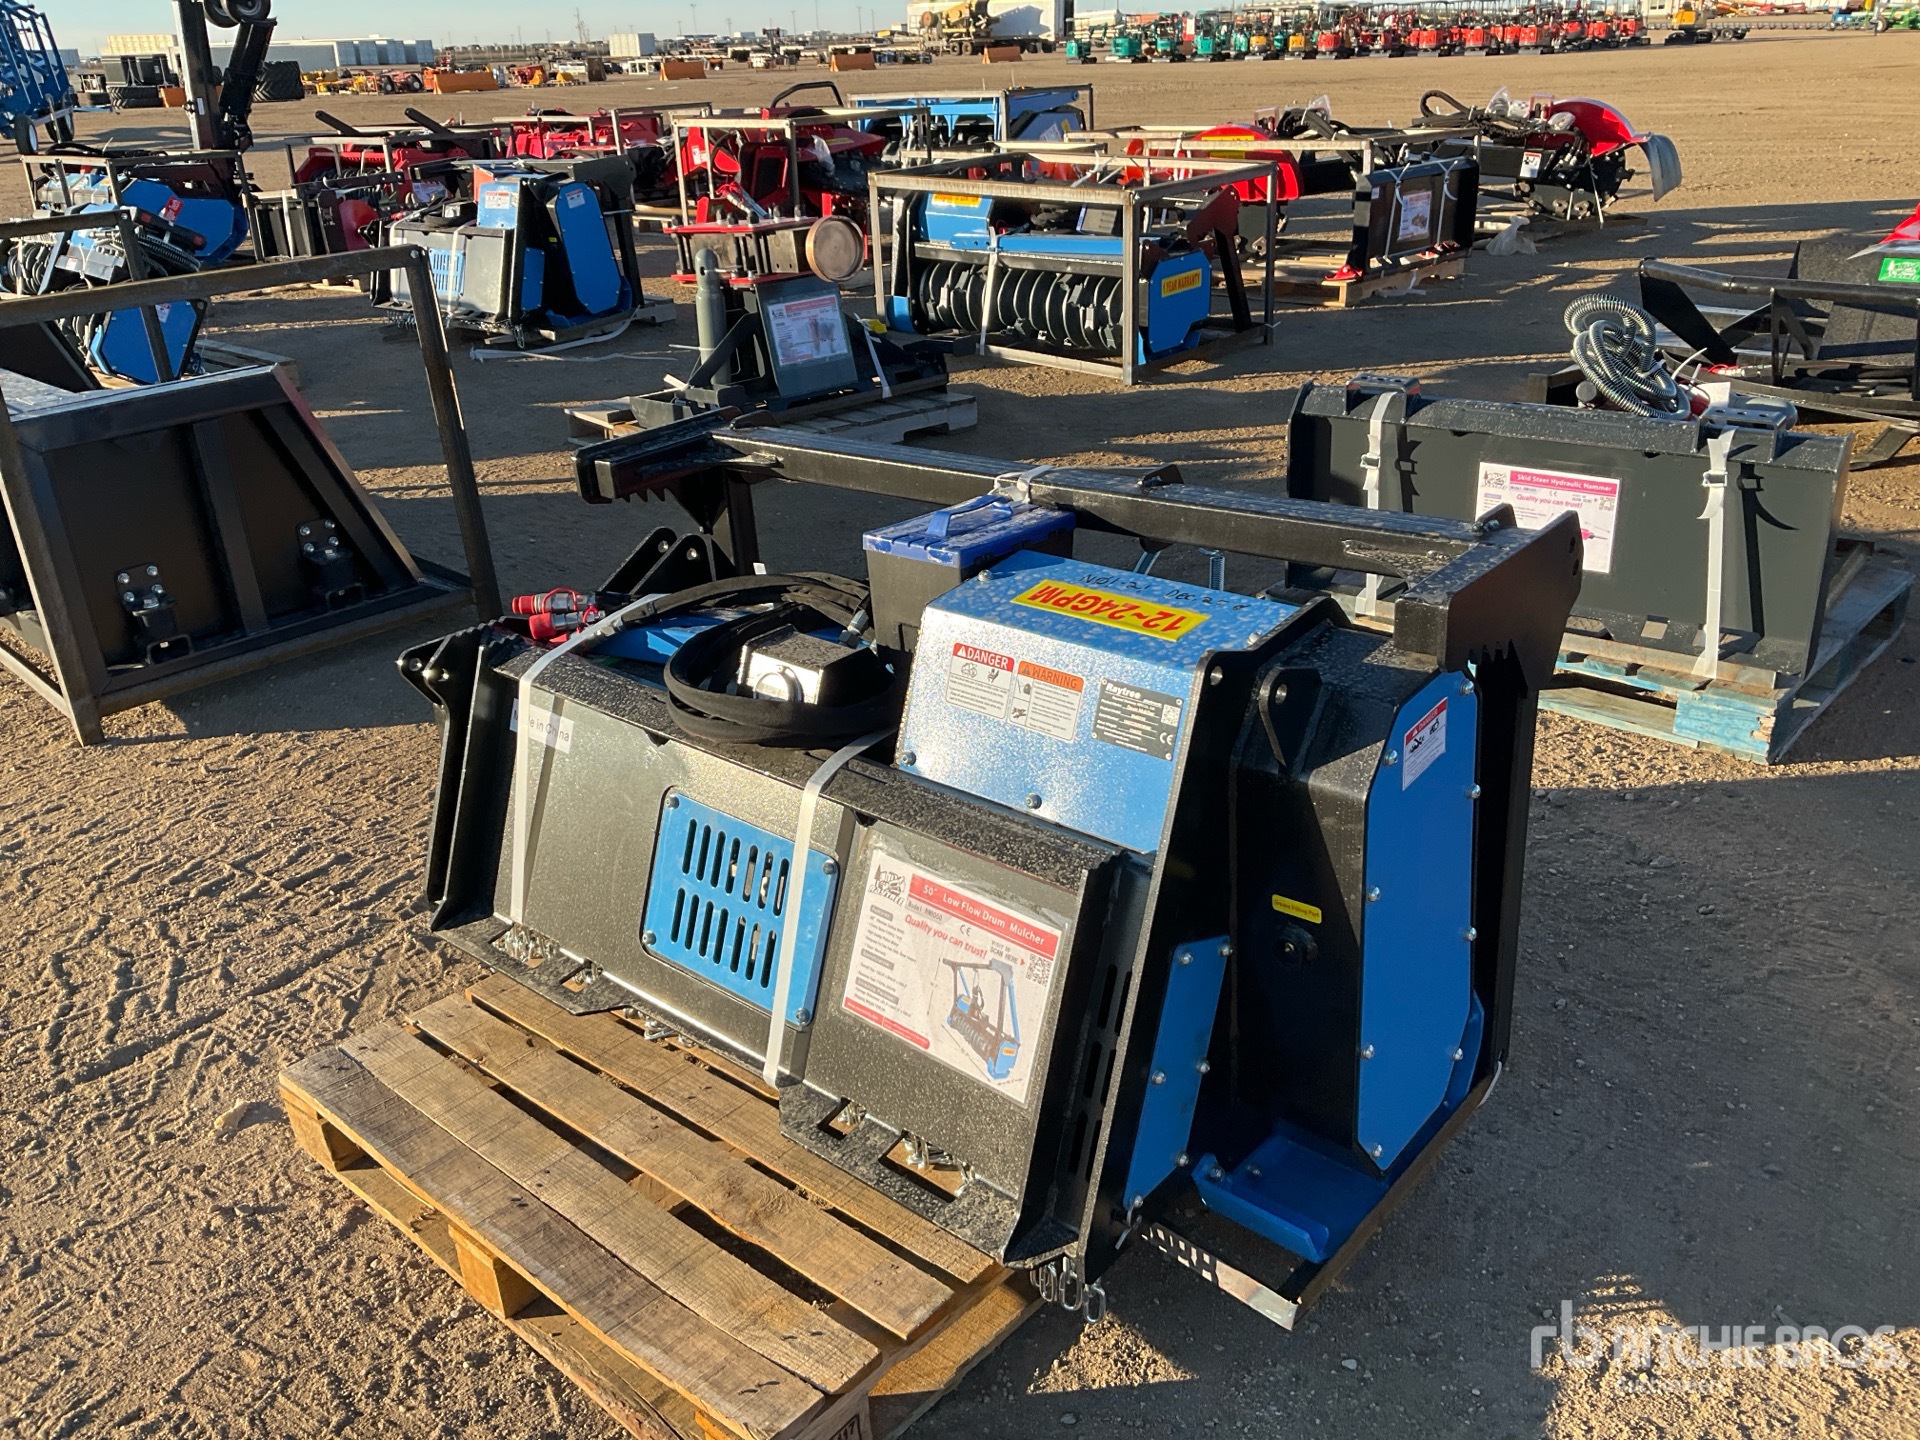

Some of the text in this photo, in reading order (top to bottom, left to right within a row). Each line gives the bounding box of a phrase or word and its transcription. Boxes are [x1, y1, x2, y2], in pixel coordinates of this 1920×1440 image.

[1532, 476, 1549, 484] Steer
[1550, 478, 1582, 489] Hydraulic
[1583, 483, 1612, 492] Hammer
[1516, 493, 1539, 503] Quality
[967, 648, 1009, 670] DANGER
[1032, 667, 1077, 689] WARNING
[1105, 682, 1142, 700] Raytree
[536, 719, 570, 742] in China
[942, 892, 960, 908] Low
[961, 901, 982, 917] Flow
[982, 910, 1007, 928] Drum
[1009, 922, 1046, 945] Mulcher
[904, 914, 933, 937] Quality
[932, 928, 949, 942] you
[950, 935, 964, 949] can
[965, 942, 988, 959] trust!
